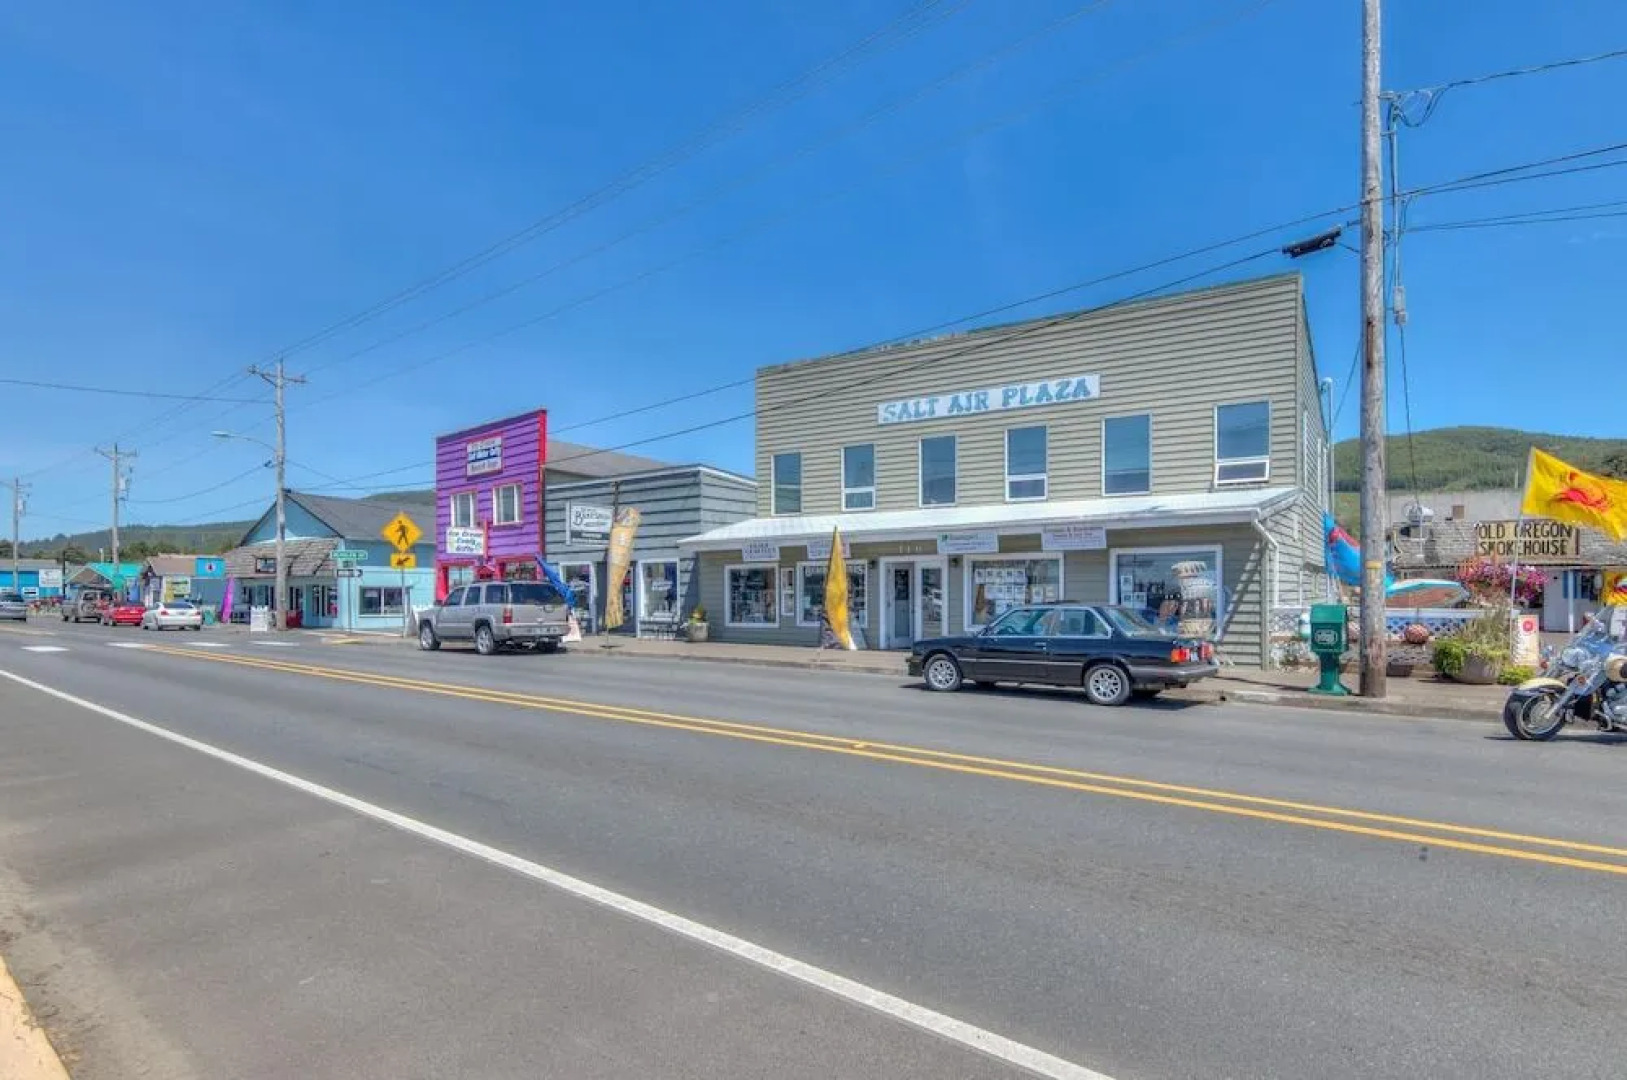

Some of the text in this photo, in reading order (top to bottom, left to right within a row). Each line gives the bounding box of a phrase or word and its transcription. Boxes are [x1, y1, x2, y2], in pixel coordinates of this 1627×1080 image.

[883, 378, 1091, 422] SALT AIR PLAZA
[1478, 523, 1506, 539] OLD
